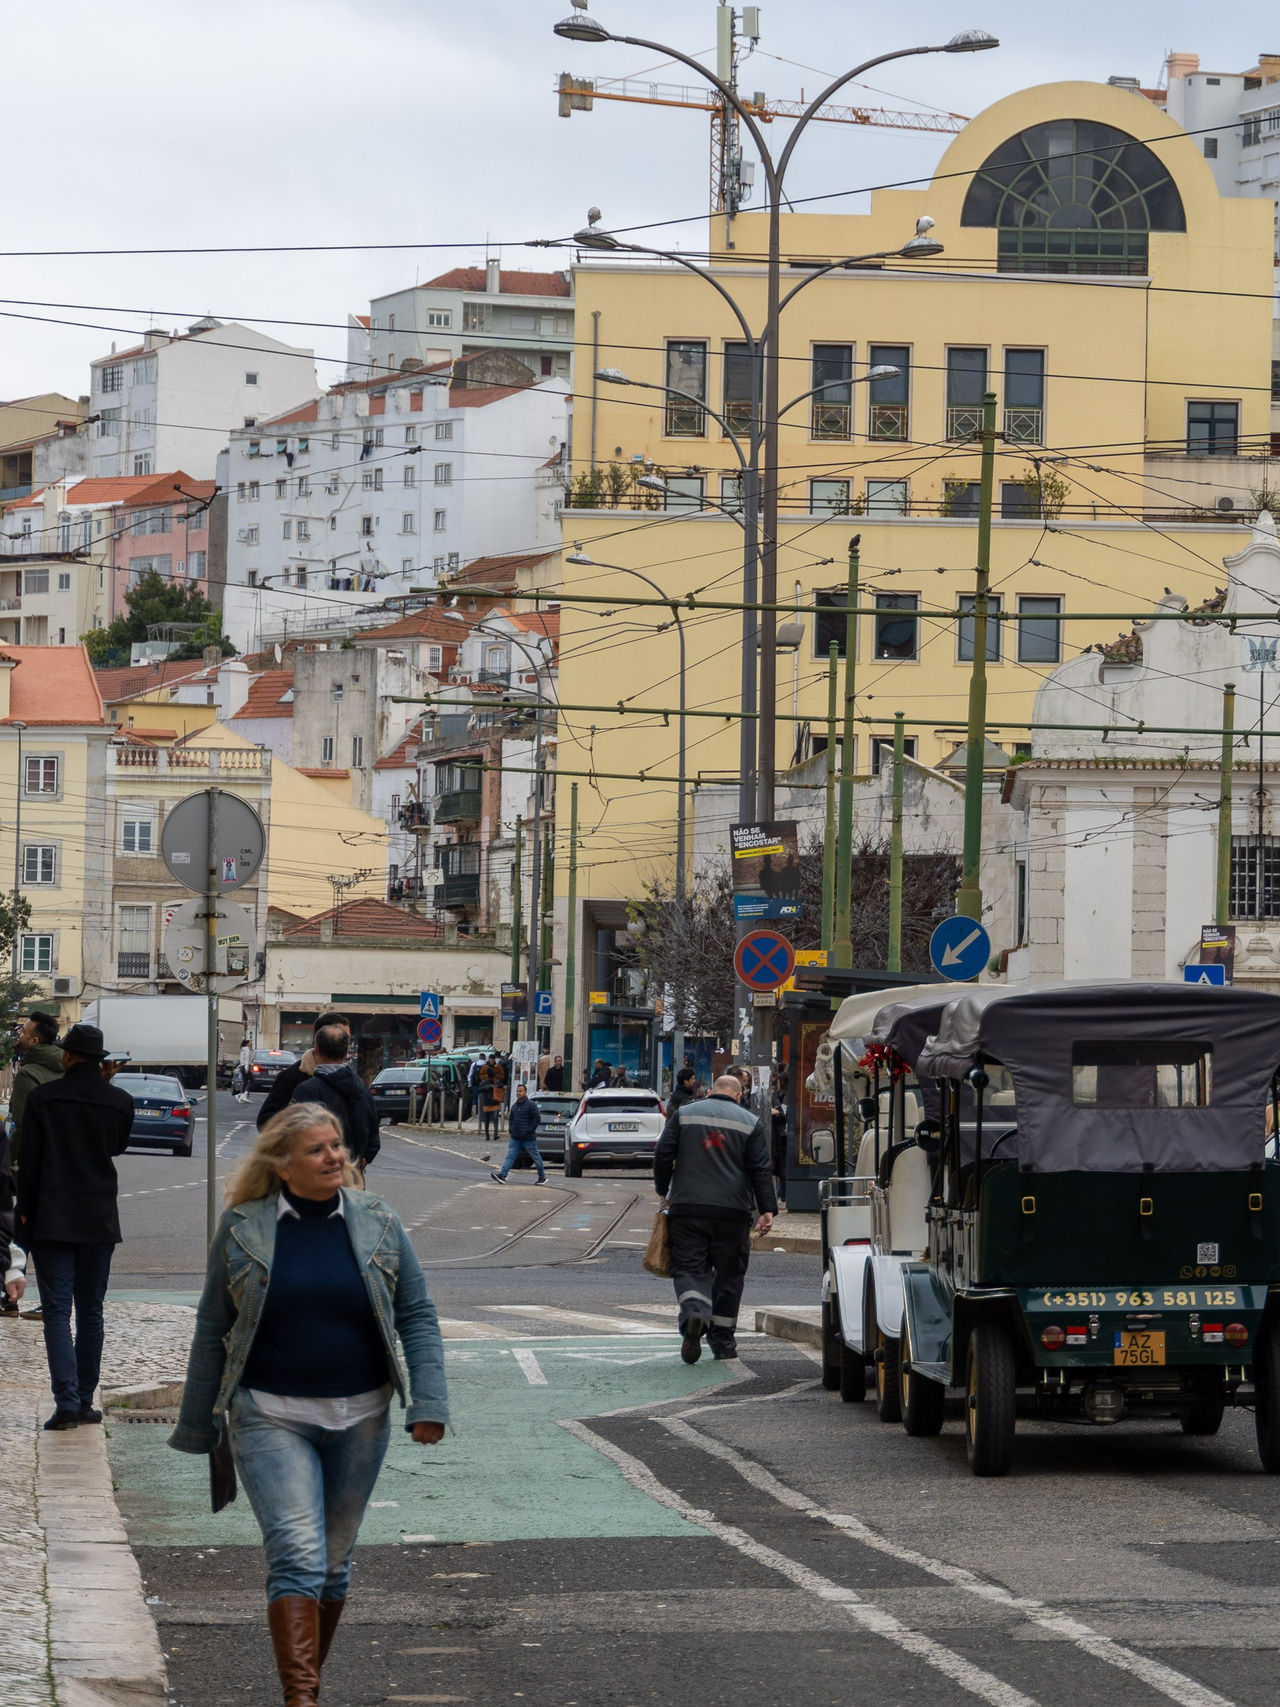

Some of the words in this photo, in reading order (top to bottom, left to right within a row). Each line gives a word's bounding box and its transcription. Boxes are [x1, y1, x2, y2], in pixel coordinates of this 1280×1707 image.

[733, 828, 749, 836] NÃO
[734, 833, 765, 842] VENHAM
[780, 905, 797, 914] ADN
[1044, 1293, 1106, 1306] (+351)
[1115, 1292, 1154, 1306] 963
[1163, 1291, 1197, 1306] 581
[1204, 1291, 1237, 1305] 125
[1128, 1335, 1151, 1349] AZ
[1120, 1351, 1159, 1364] 75GL
